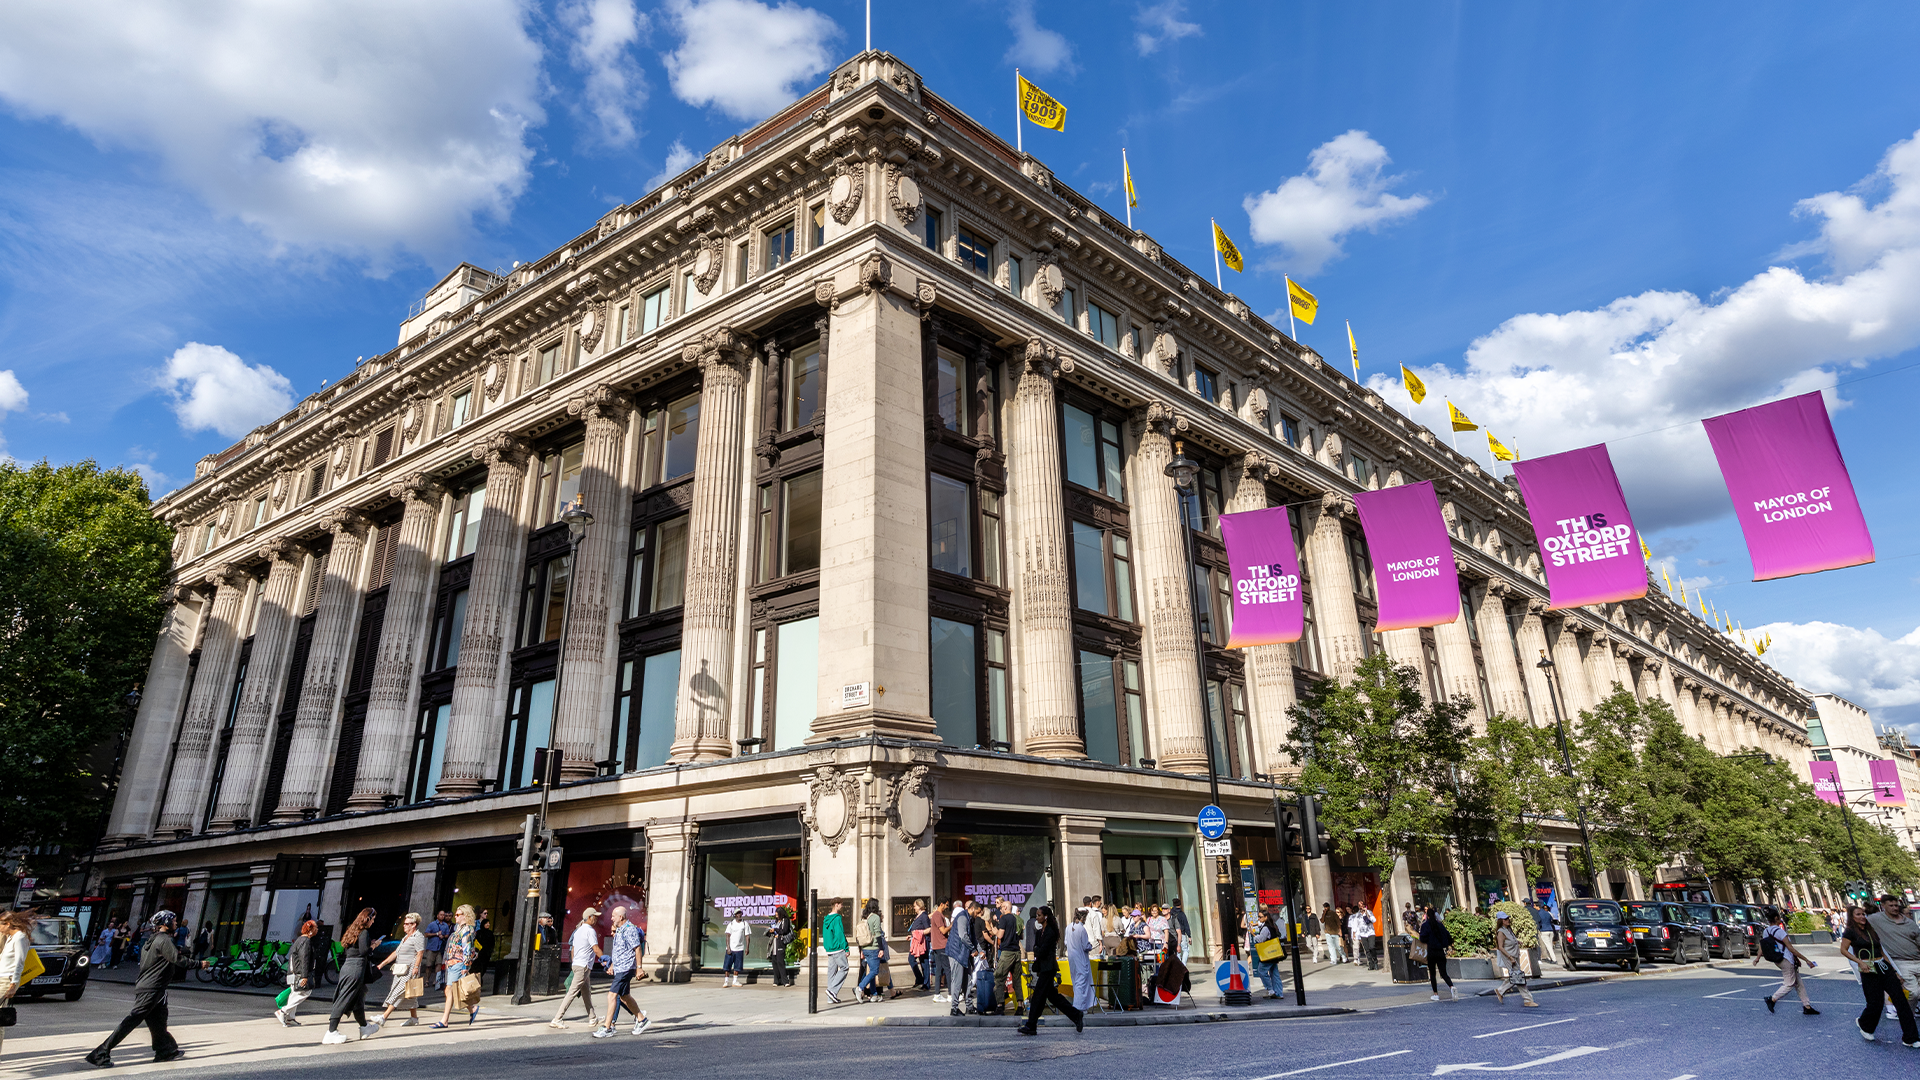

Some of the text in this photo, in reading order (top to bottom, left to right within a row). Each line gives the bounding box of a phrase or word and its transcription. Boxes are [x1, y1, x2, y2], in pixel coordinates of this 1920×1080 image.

[1025, 92, 1058, 109] SINCE
[1024, 100, 1057, 120] 1909
[1754, 486, 1830, 512] MAYOR OF
[1764, 501, 1832, 523] LONDON
[1556, 513, 1607, 534] THIS
[1544, 524, 1630, 552] OXFORD
[1551, 539, 1630, 566] STREET
[1248, 564, 1282, 578] THIS
[1387, 556, 1440, 572] MAYOR OF
[1237, 575, 1298, 592] OXFORD
[1393, 568, 1439, 582] LONDON
[1240, 588, 1297, 604] STREET
[965, 884, 1034, 895] SURROUNDED
[714, 894, 788, 908] SURROUNDED
[975, 895, 989, 905] BY
